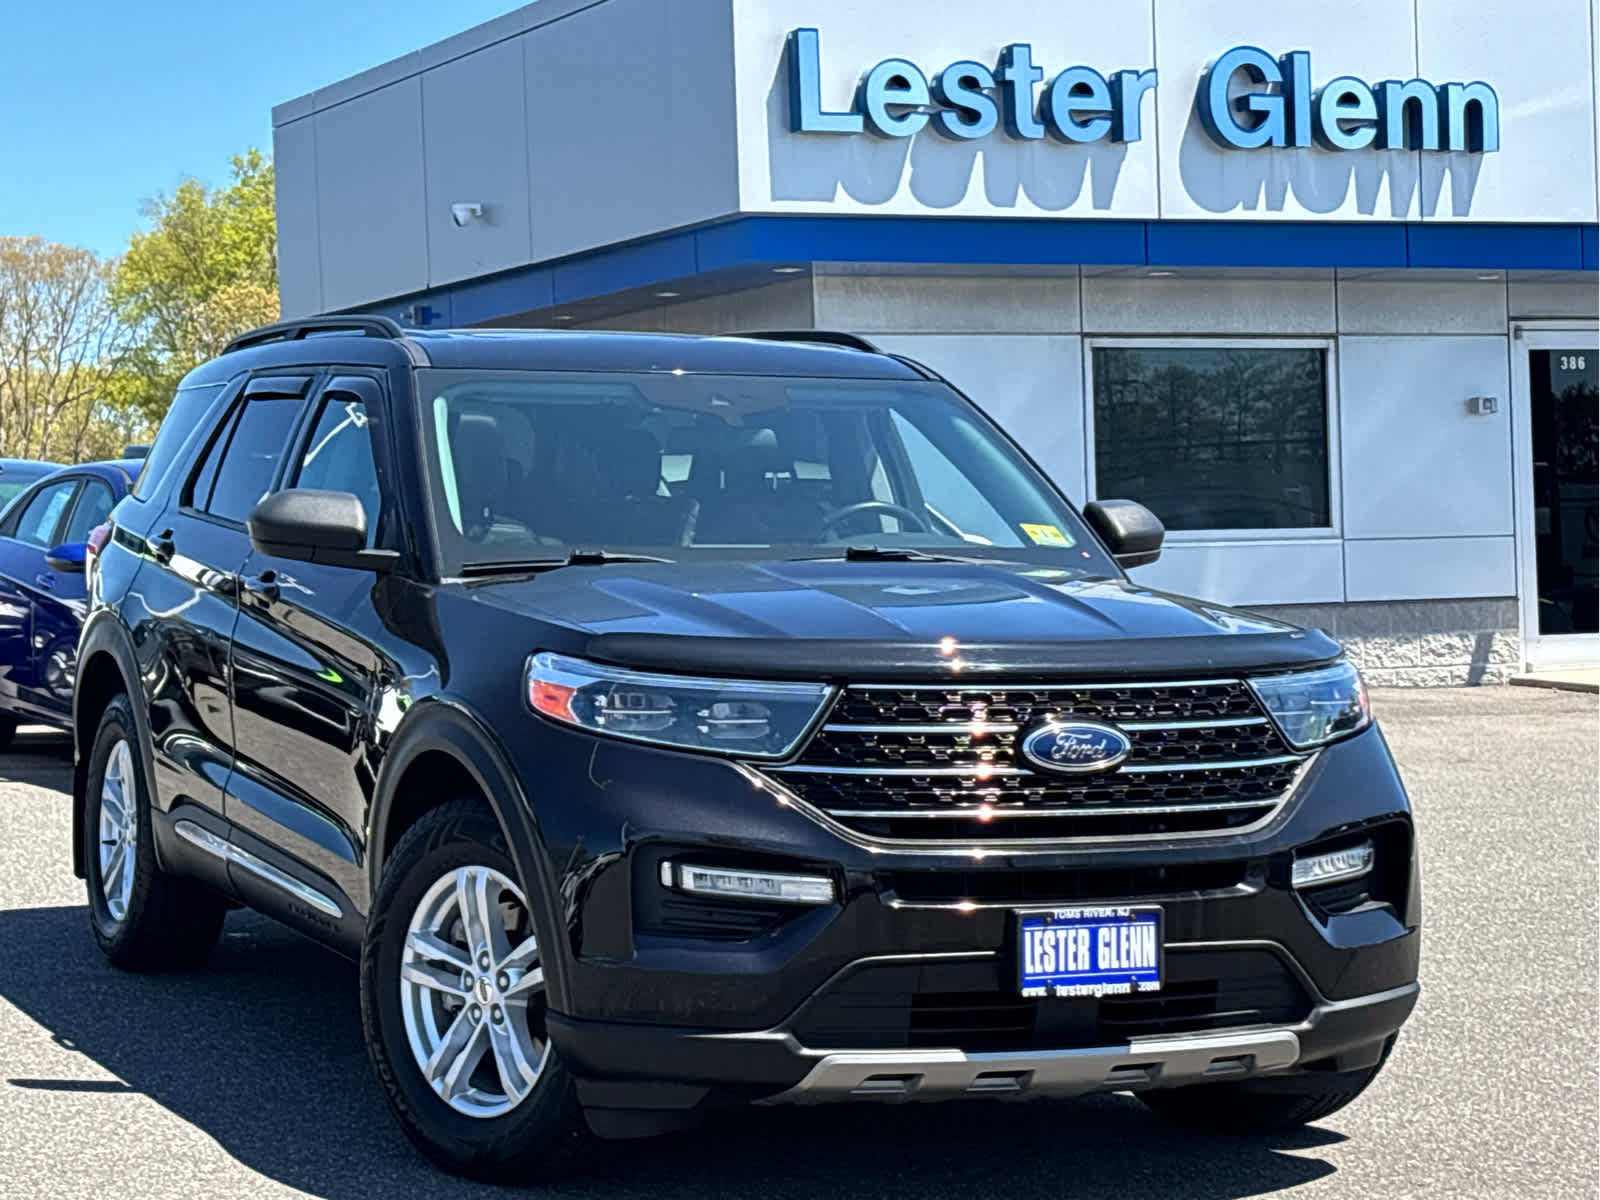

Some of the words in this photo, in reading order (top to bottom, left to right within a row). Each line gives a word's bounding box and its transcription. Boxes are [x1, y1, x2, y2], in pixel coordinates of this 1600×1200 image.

[789, 27, 1158, 143] Lester
[1203, 45, 1500, 153] Glenn
[1560, 356, 1586, 370] 386
[1051, 732, 1107, 760] Ford
[1025, 929, 1090, 974] LESTER
[1098, 926, 1156, 969] GLENN
